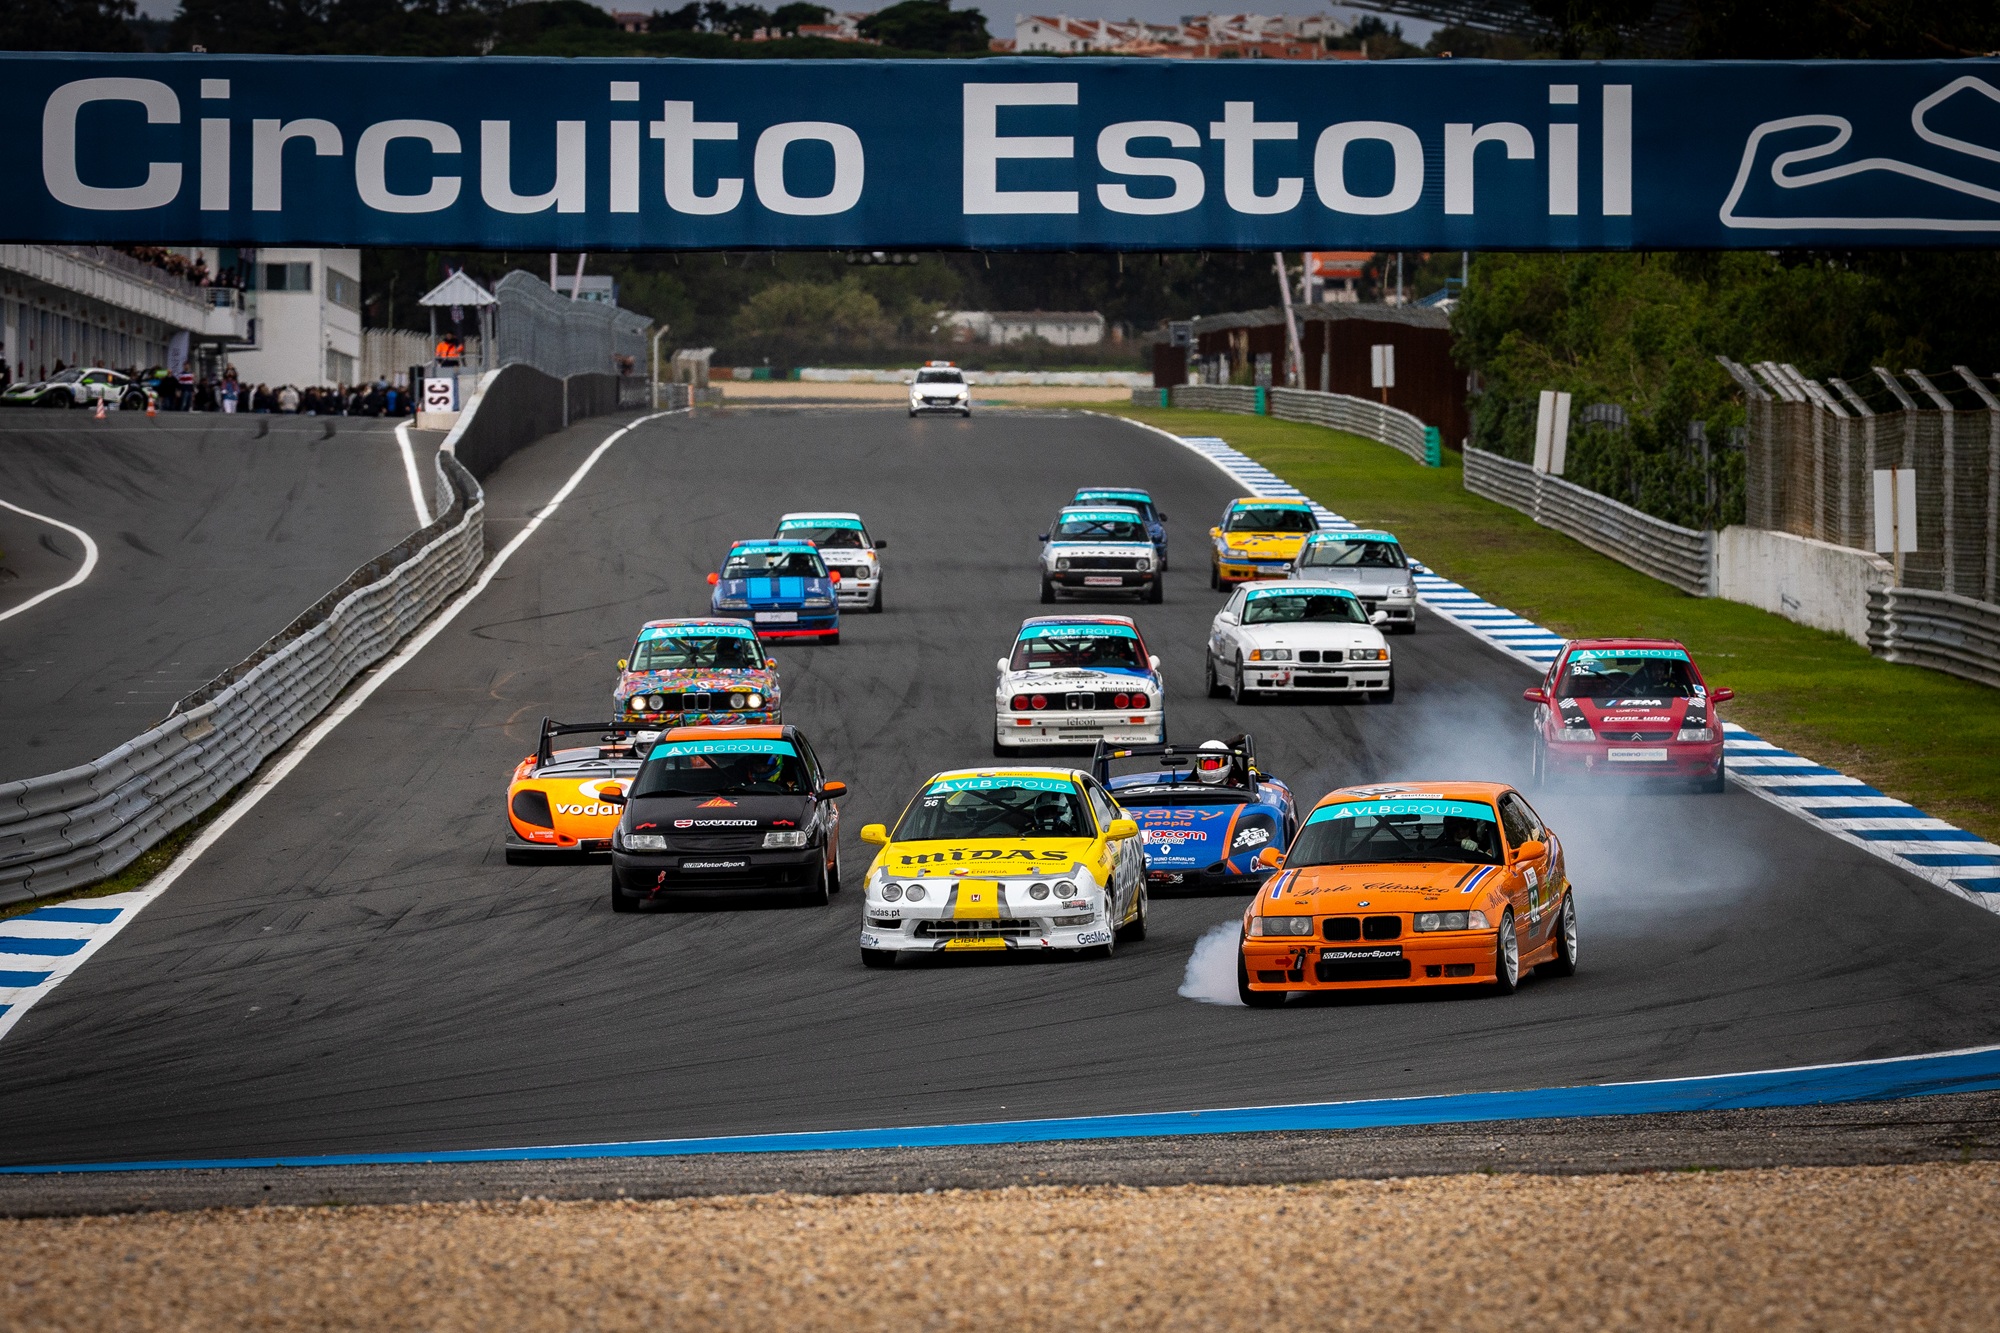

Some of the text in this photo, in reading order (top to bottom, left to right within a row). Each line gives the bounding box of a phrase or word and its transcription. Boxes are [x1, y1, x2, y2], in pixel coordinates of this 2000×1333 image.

[43, 77, 1632, 215] Circuito Estoril
[427, 384, 450, 405] SC
[1144, 820, 1192, 828] people
